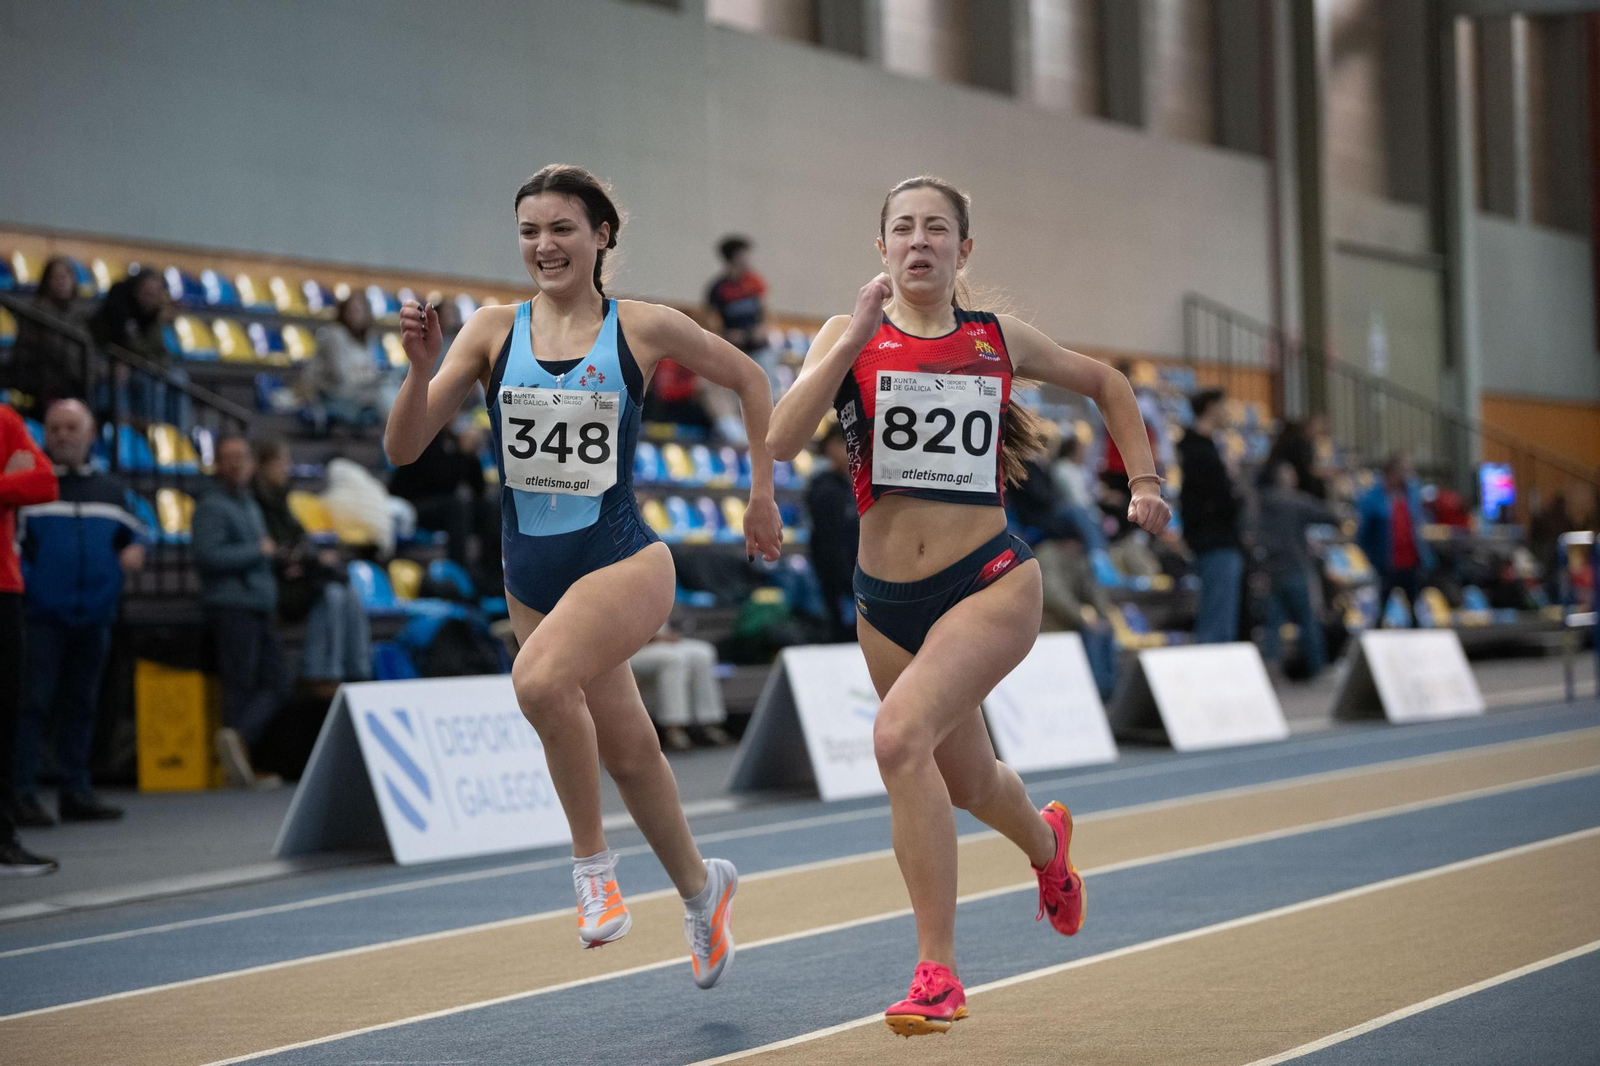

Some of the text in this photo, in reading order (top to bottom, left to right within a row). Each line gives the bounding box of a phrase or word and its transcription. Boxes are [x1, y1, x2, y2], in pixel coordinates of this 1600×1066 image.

[507, 417, 611, 464] 348
[882, 405, 993, 457] 820
[525, 476, 590, 491] atletismo.gal
[901, 469, 973, 485] atletismo.gal
